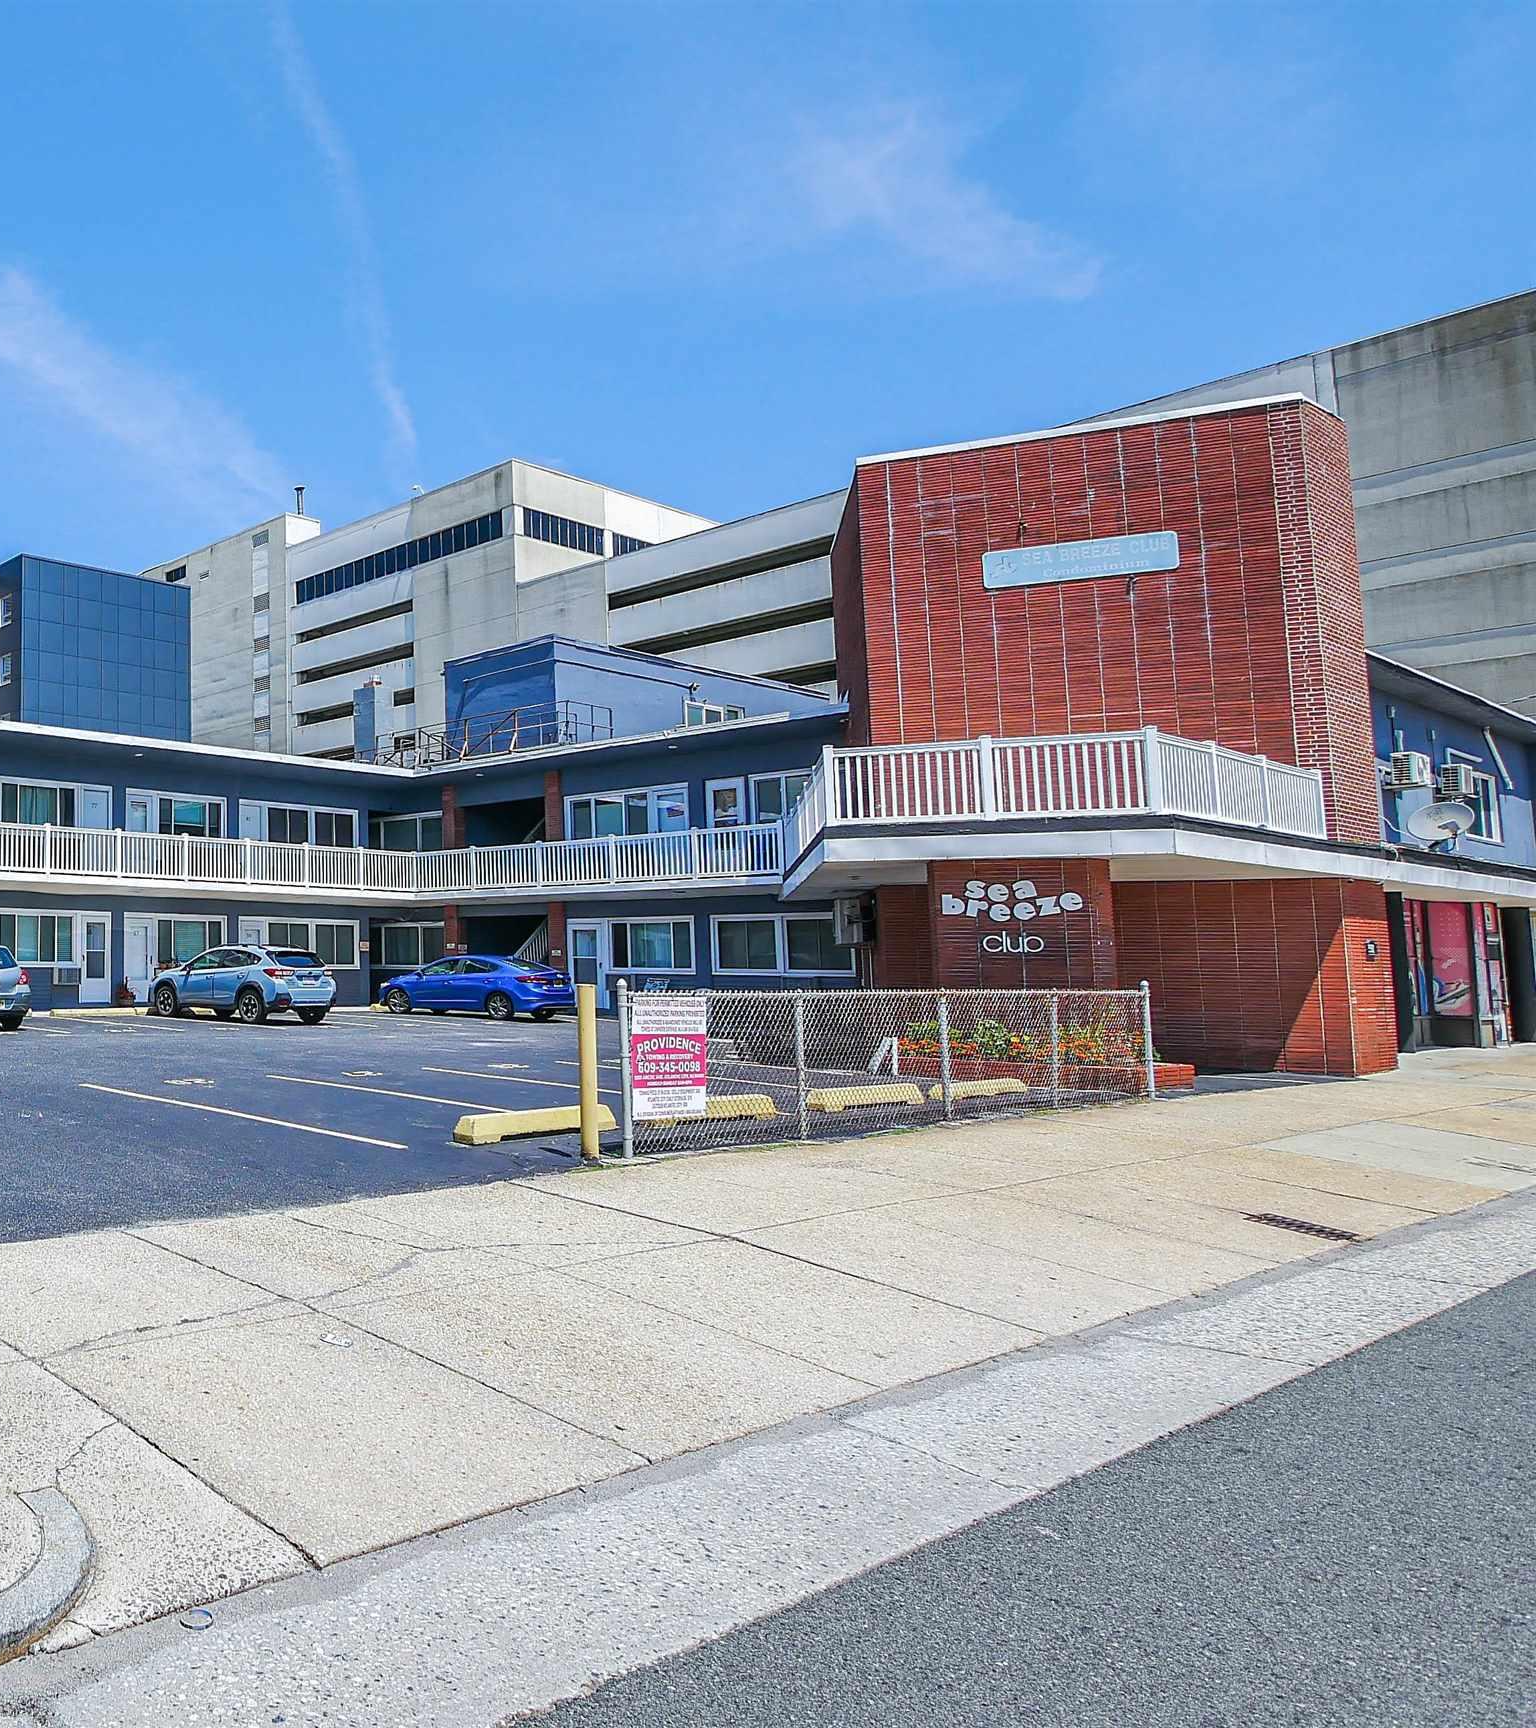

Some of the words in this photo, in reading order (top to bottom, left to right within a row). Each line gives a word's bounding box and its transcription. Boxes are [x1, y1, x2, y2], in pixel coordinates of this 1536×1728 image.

[1021, 551, 1052, 567] SEA
[1059, 542, 1121, 563] BREEZE
[1129, 537, 1170, 555] CLUB
[1042, 559, 1151, 578] Condominium
[964, 879, 1038, 903] sea
[941, 892, 1084, 922] breeze
[982, 930, 1045, 953] club
[636, 1037, 702, 1054] PROVIDENCE
[637, 1061, 701, 1073] 609-345-0098
